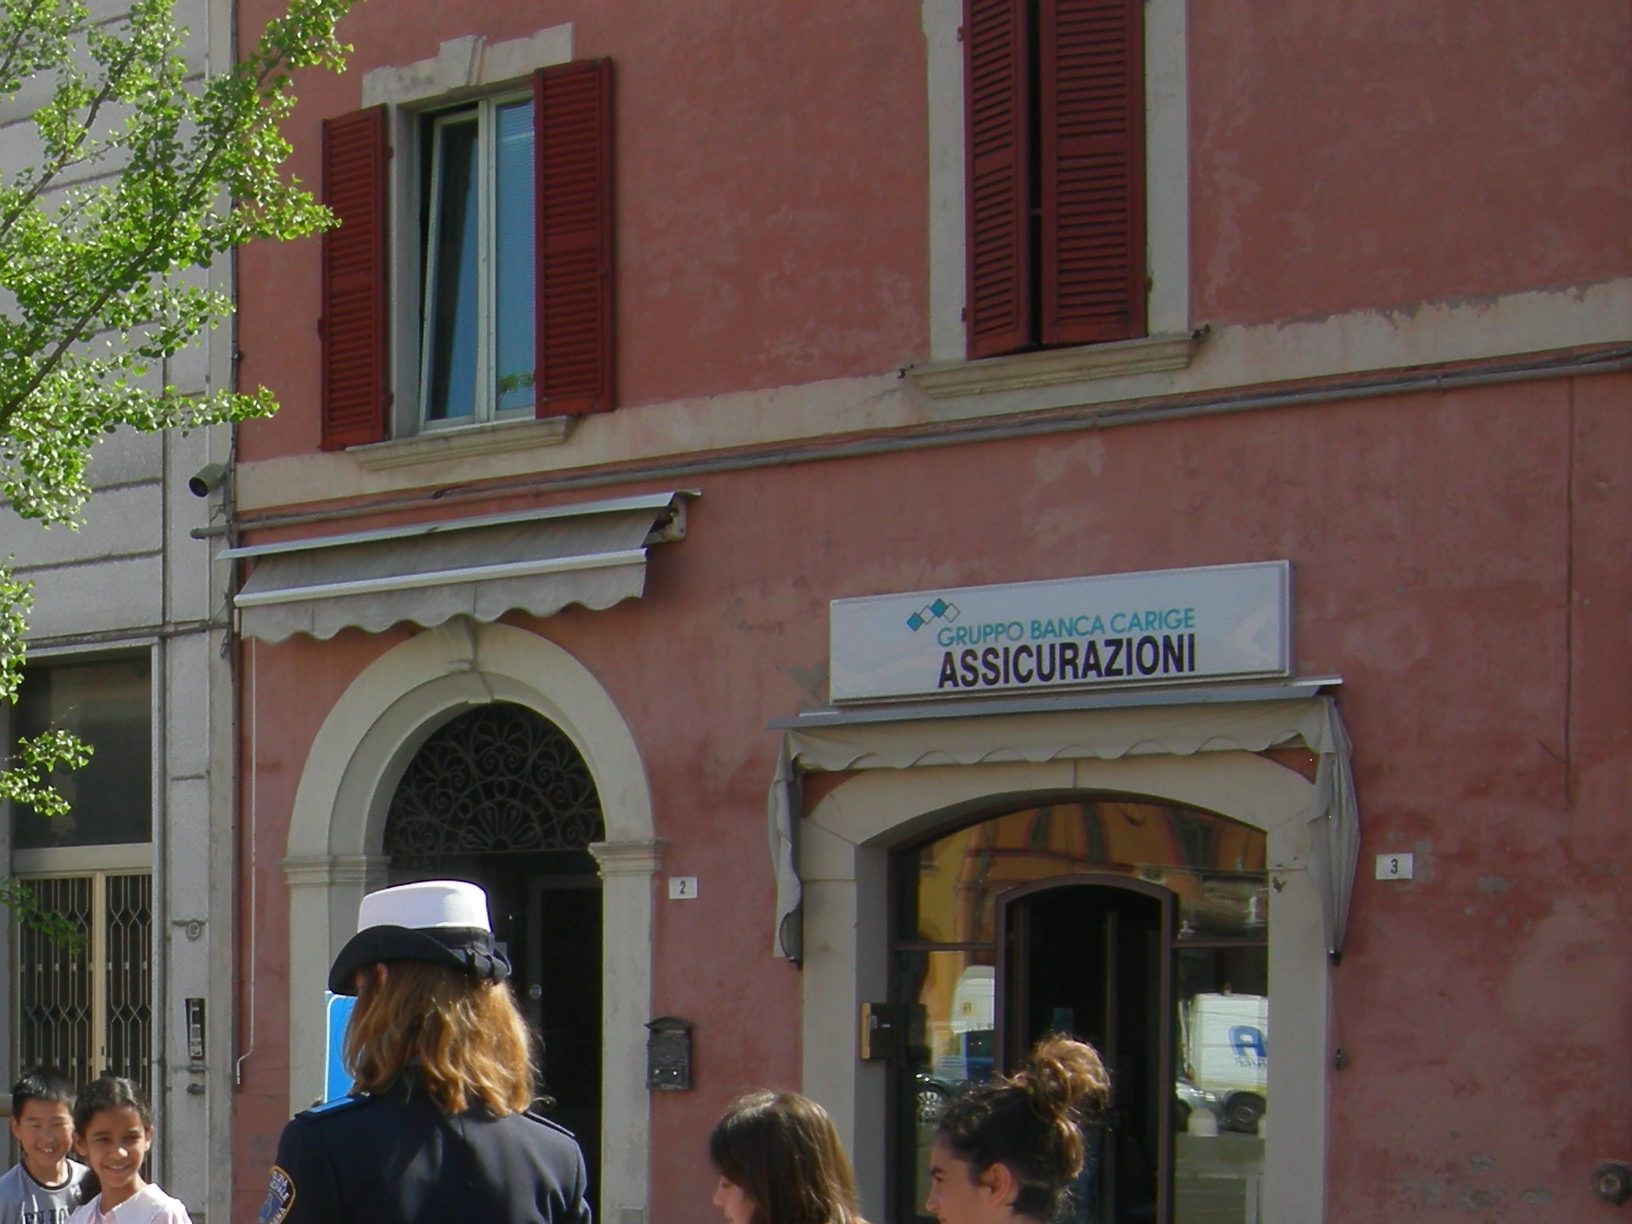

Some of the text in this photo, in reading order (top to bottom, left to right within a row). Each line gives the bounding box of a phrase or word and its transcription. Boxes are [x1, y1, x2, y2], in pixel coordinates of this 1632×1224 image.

[937, 607, 1195, 648] GRUPPO BANCA CARIGE
[938, 632, 1196, 690] ASSICURAZIONI
[1390, 858, 1399, 875] 3
[679, 880, 687, 895] 2
